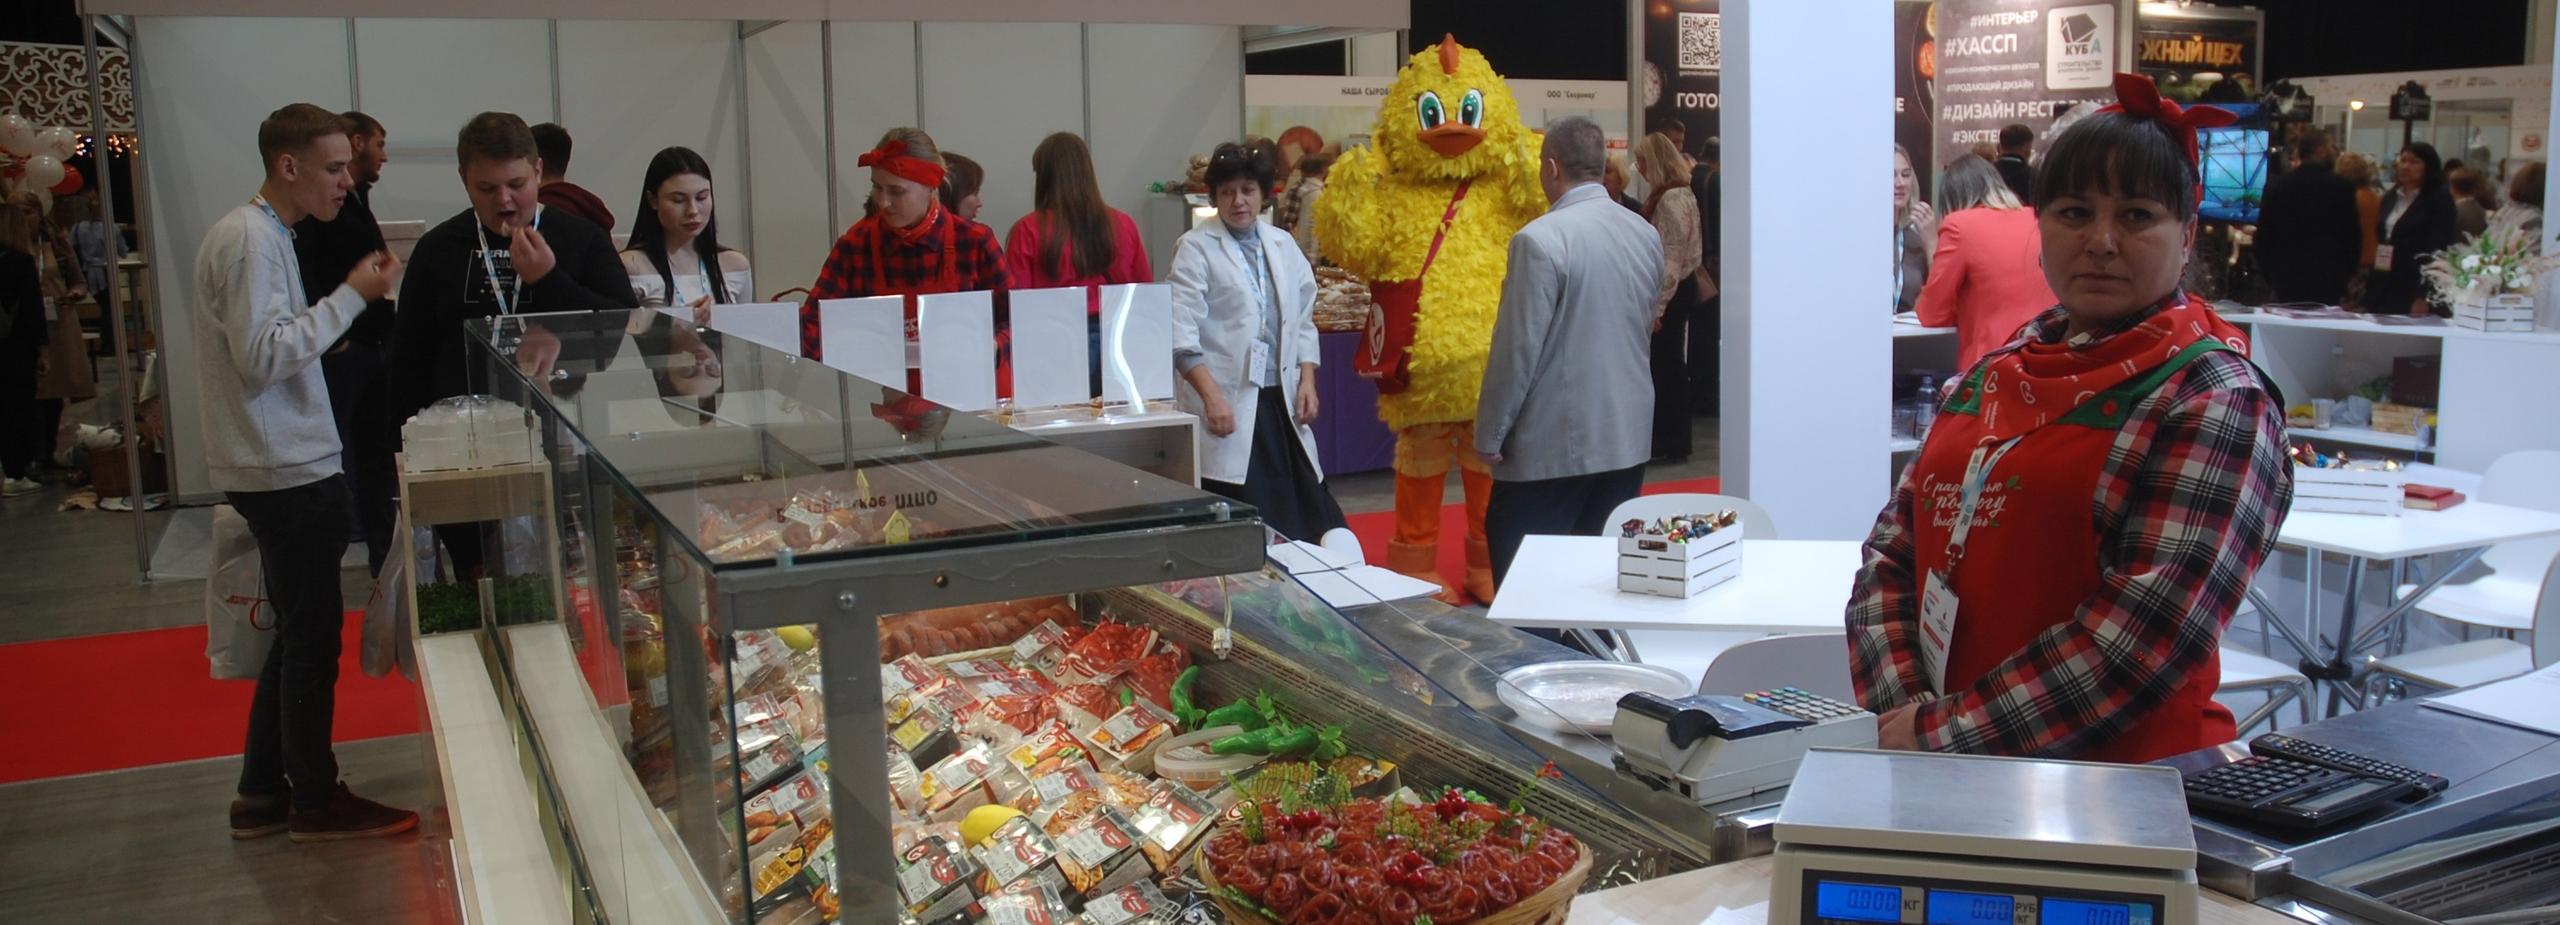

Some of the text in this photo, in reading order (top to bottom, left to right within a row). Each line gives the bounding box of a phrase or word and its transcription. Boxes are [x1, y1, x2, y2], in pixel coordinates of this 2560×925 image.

[1970, 10, 2038, 28] #ИНТЕРЬЕР
[1945, 33, 2017, 57] #ХАССП
[2139, 34, 2243, 67] ЖНЫЙ ЦЕХ
[1547, 90, 1561, 98] ООО
[1677, 92, 1721, 108] ГОТО
[1943, 100, 2014, 122] #ДИЗАЙН
[1952, 130, 2000, 144] #ЭКСТЕ
[1932, 480, 2004, 498] радью
[1936, 495, 2007, 518] поогу
[1933, 511, 1989, 532] выбть
[1903, 900, 1921, 911] КГ
[2015, 903, 2036, 913] РУБ
